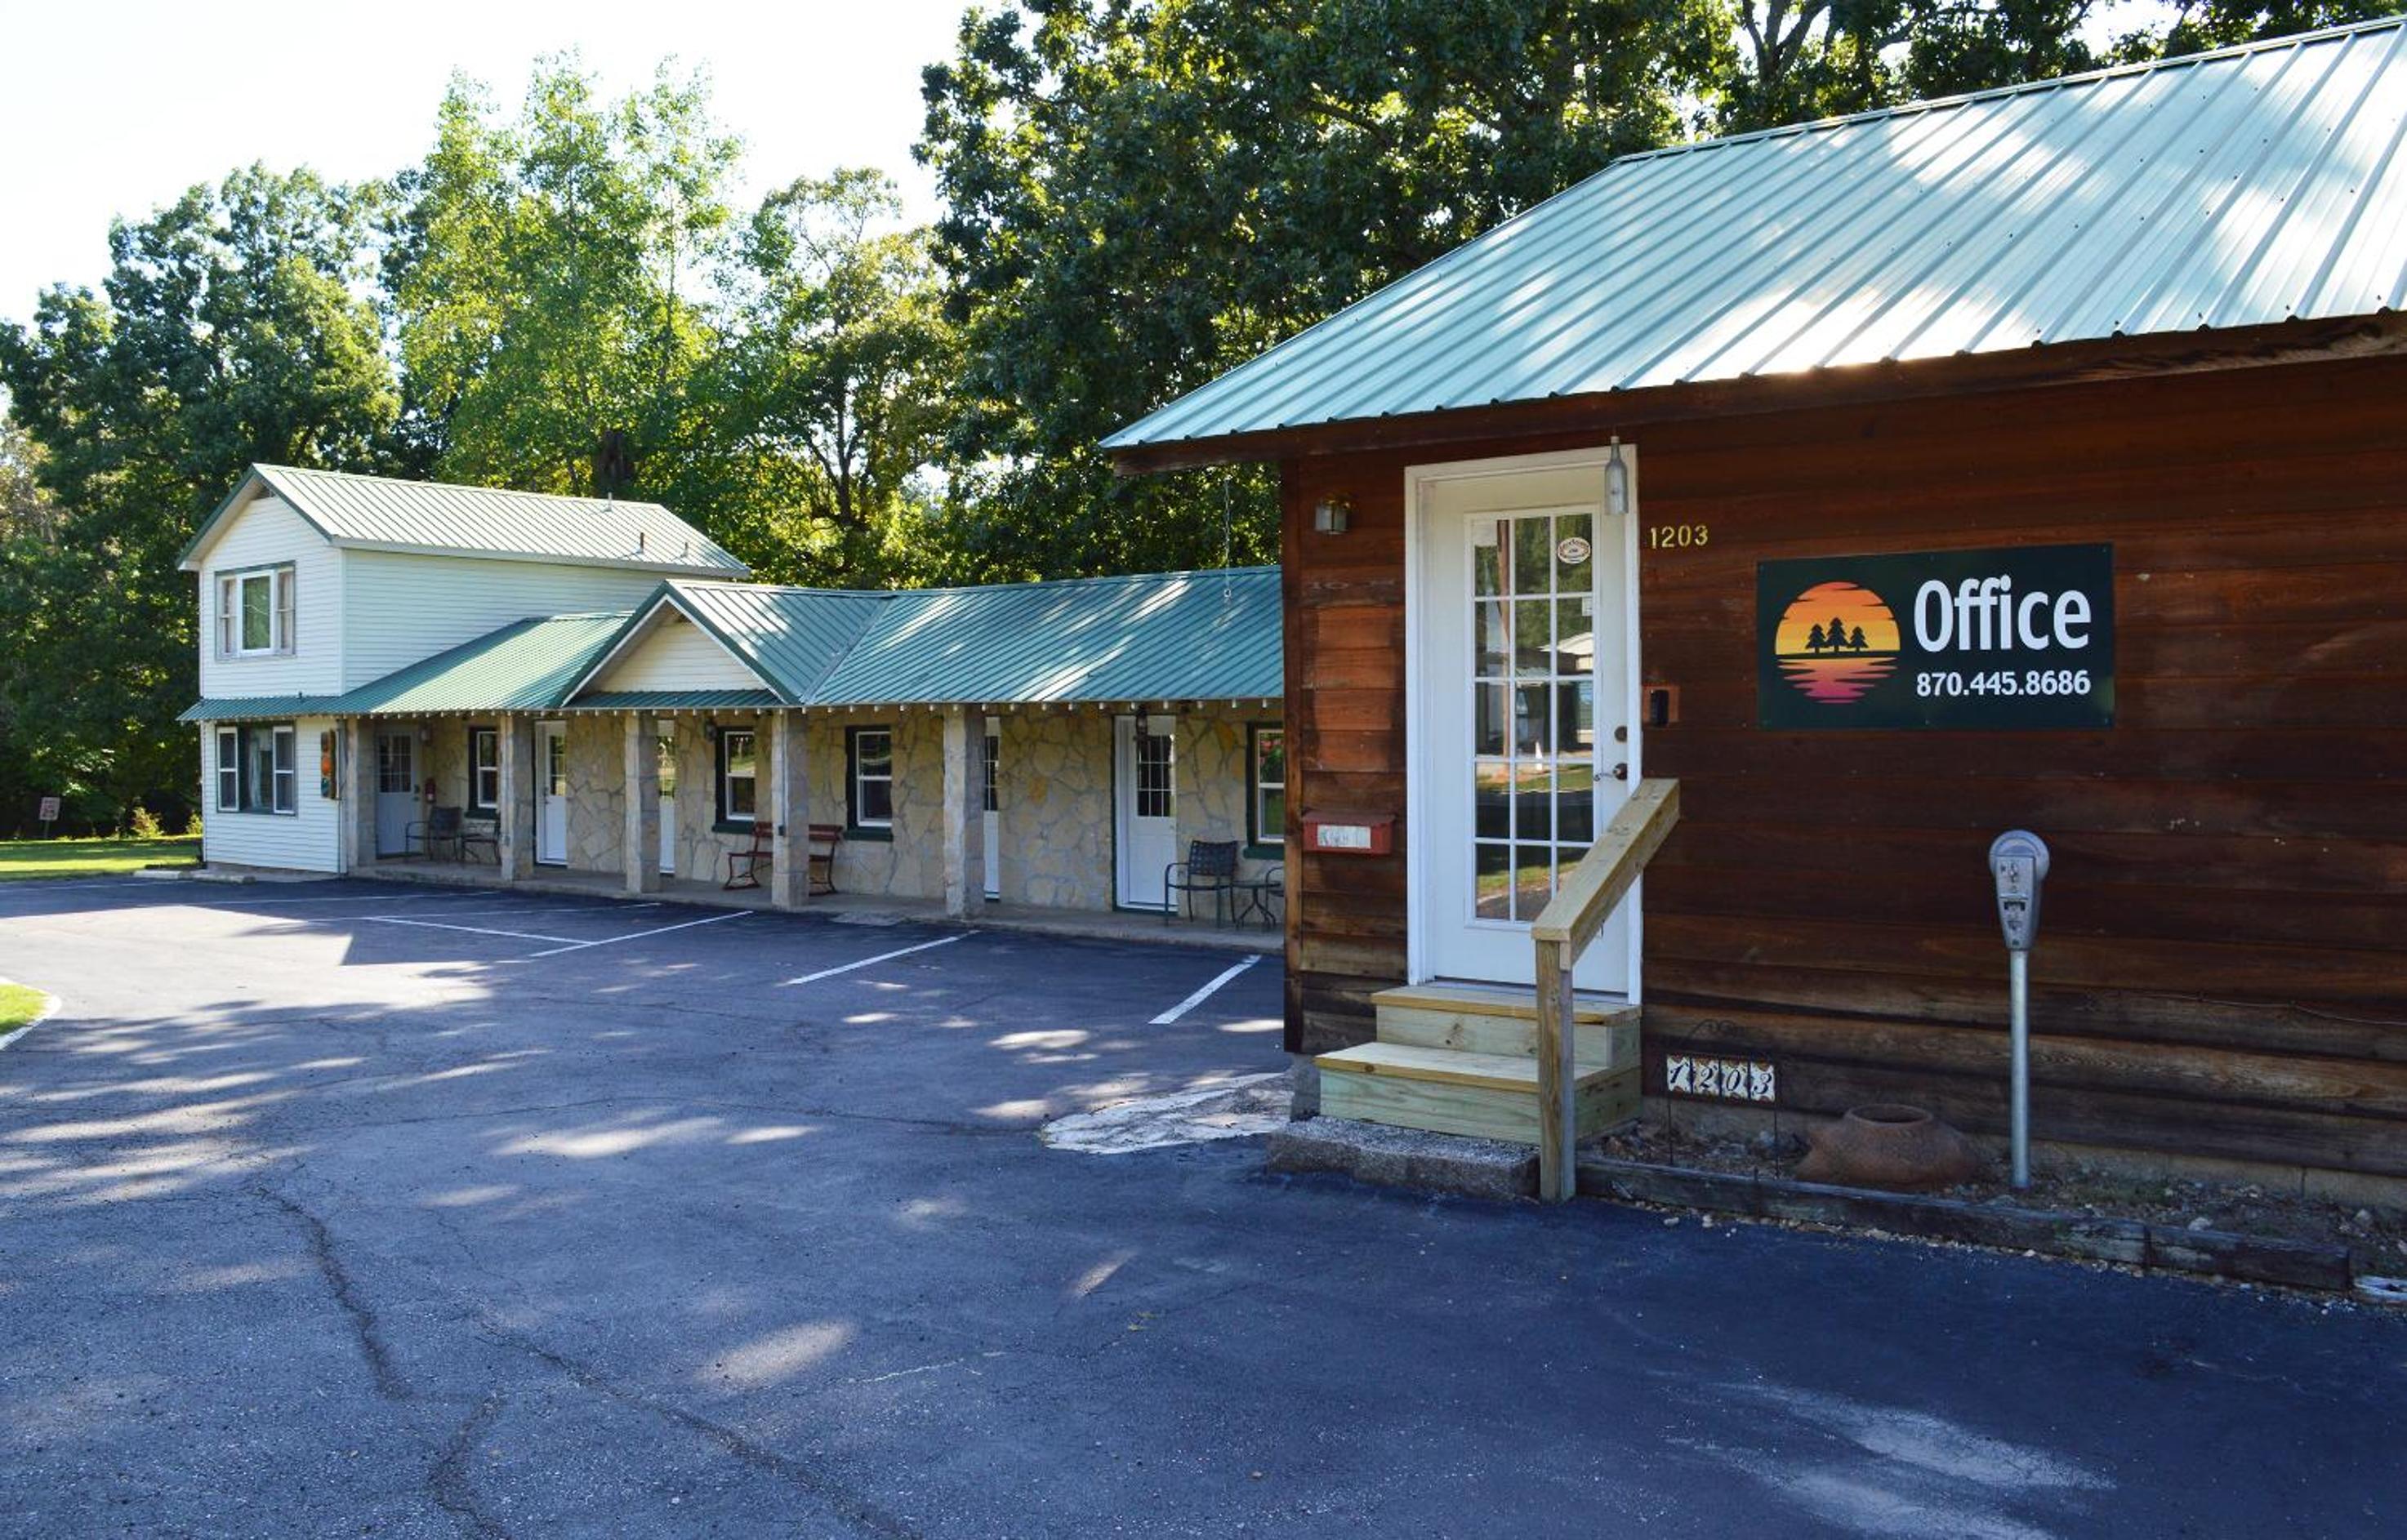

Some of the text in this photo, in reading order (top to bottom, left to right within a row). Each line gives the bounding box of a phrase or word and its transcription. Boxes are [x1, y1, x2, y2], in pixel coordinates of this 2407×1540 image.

[1651, 525, 1709, 550] 1203
[1914, 574, 2093, 652] Office
[1916, 670, 2092, 697] 870.445.8686
[1669, 1063, 1773, 1095] 1203
